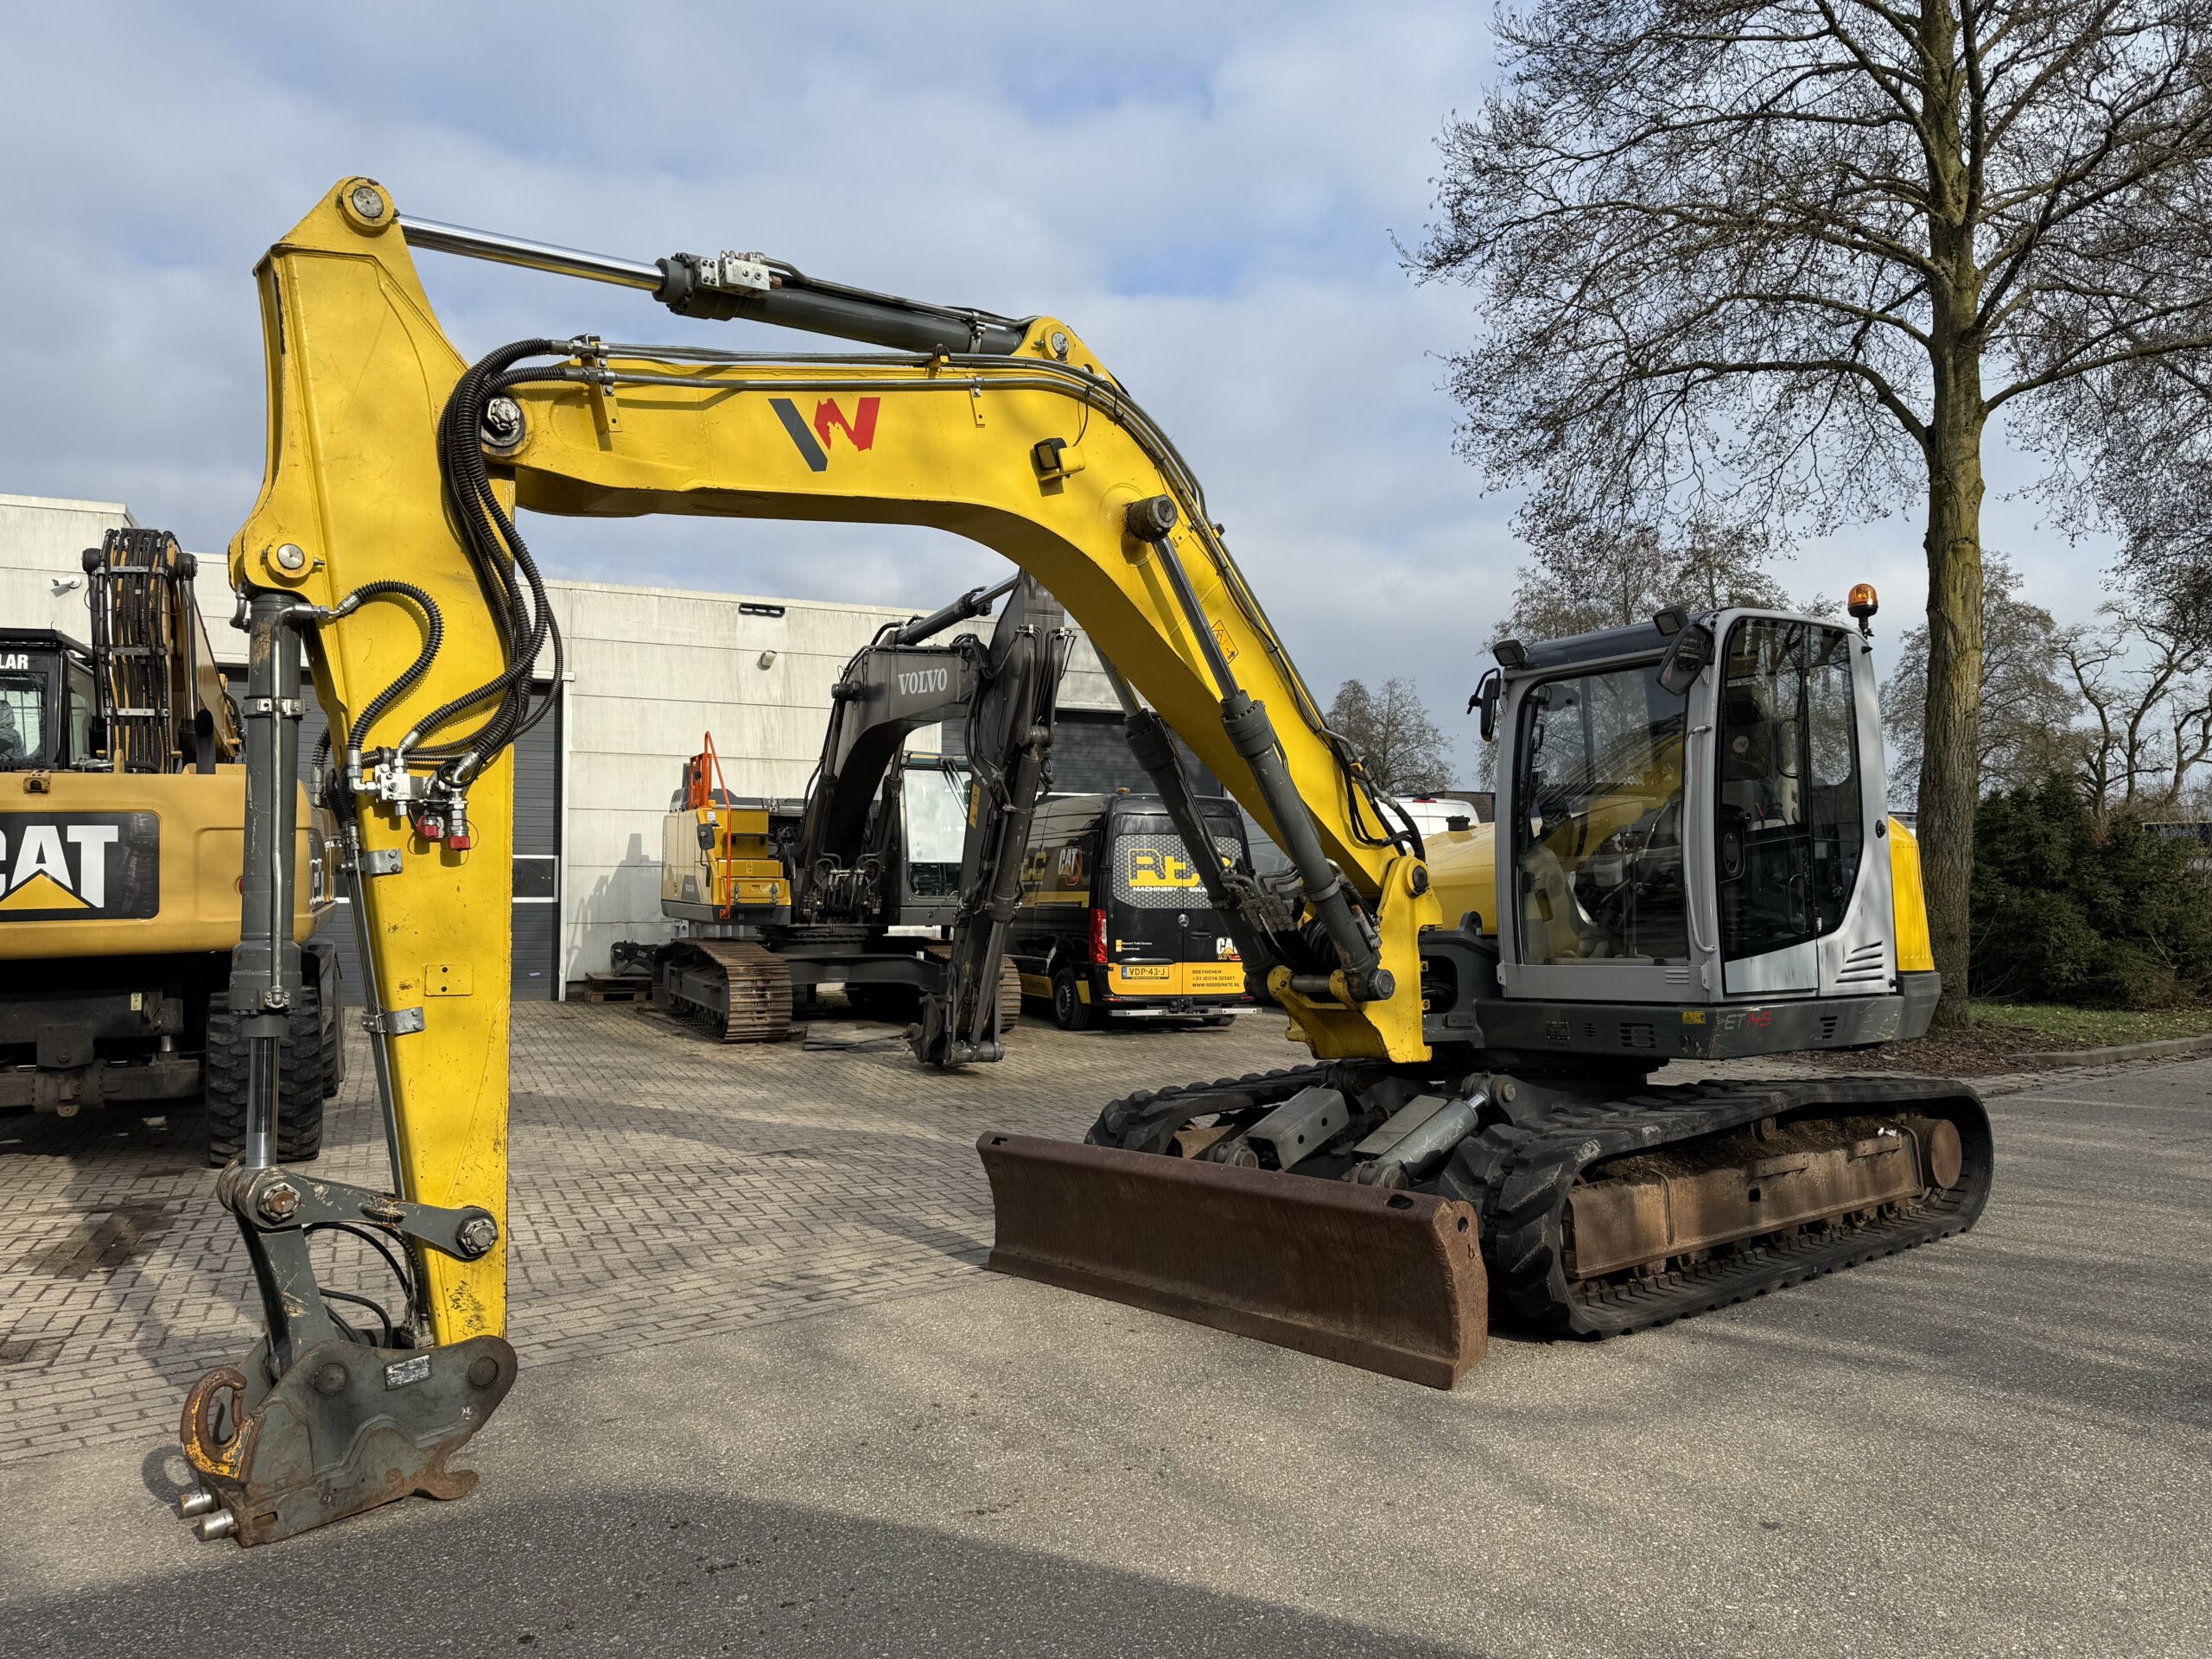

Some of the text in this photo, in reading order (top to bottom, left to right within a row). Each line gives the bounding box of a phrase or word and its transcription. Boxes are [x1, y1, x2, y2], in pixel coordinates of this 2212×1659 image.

[898, 668, 948, 695] VOLVO
[0, 825, 118, 908] AT
[1058, 849, 1078, 875] CAT
